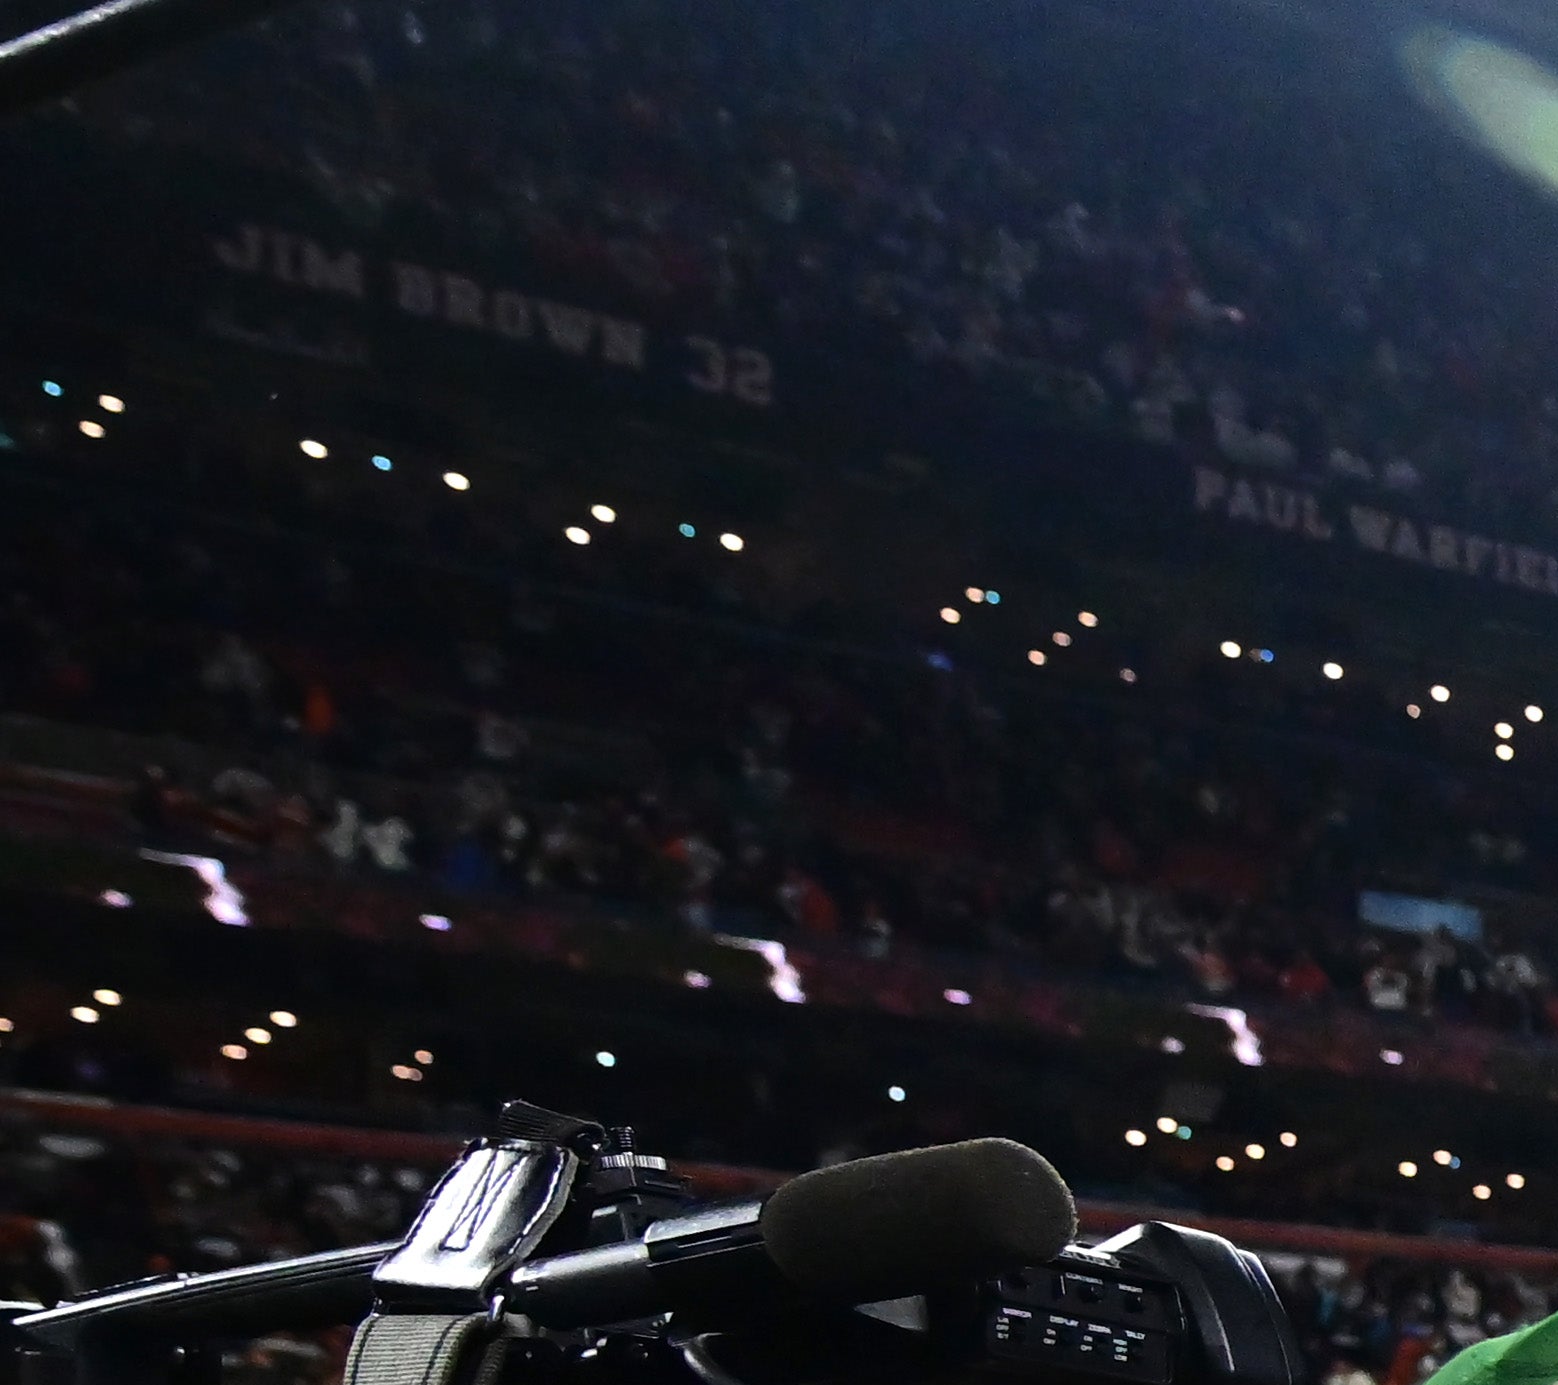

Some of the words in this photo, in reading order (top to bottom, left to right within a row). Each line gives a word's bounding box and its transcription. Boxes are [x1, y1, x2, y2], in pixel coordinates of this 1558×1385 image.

[209, 222, 365, 299] JIM
[390, 259, 648, 370] BROWN
[682, 332, 775, 406] 32
[1192, 467, 1331, 541] PAUL
